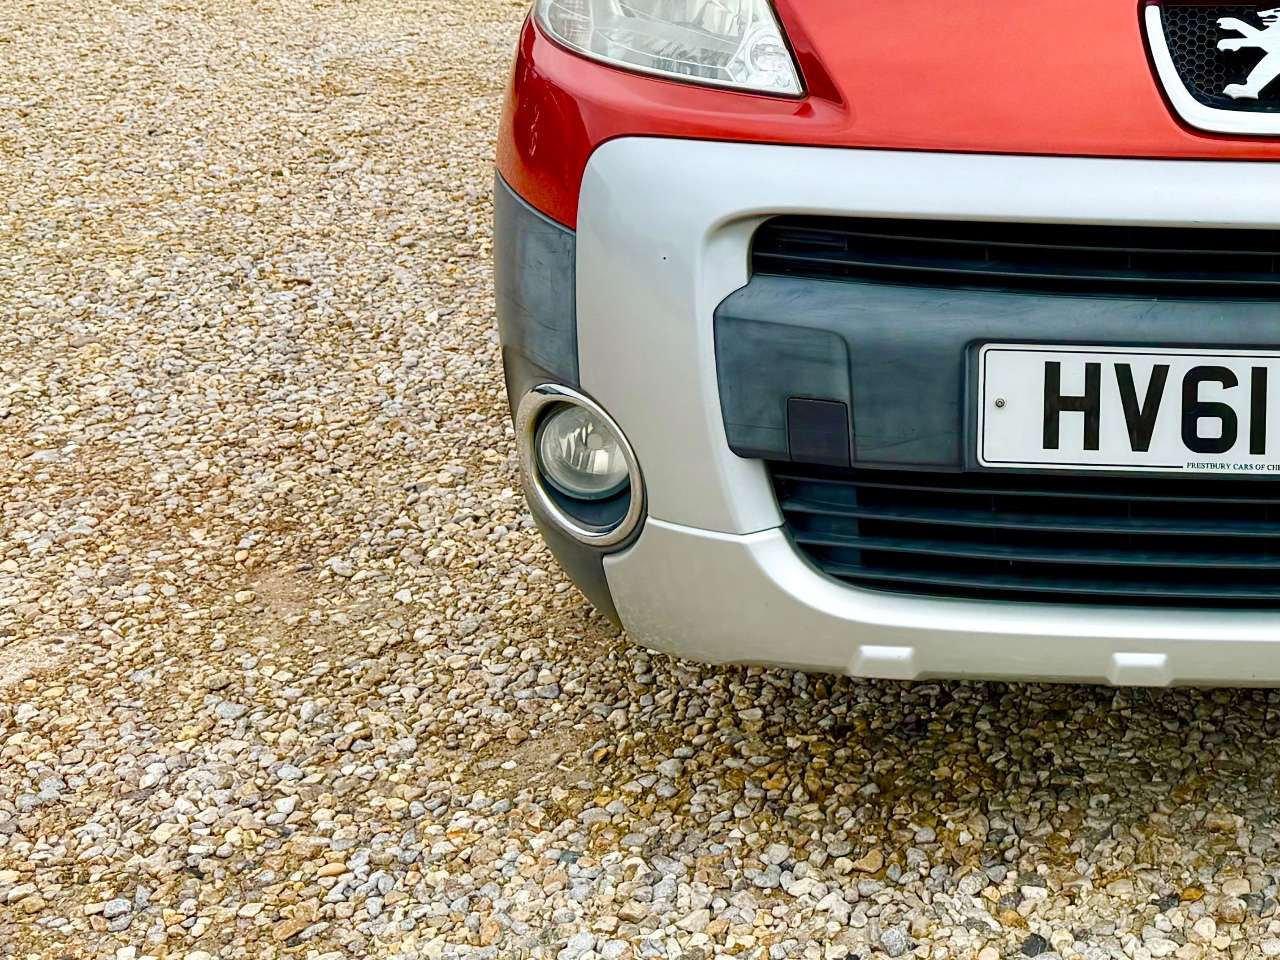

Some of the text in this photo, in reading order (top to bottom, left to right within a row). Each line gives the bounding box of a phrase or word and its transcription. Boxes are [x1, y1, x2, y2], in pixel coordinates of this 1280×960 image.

[1042, 360, 1267, 454] HV61
[1186, 462, 1231, 470] PRESTBURY
[1233, 463, 1254, 471] CARS
[1255, 463, 1265, 471] OF
